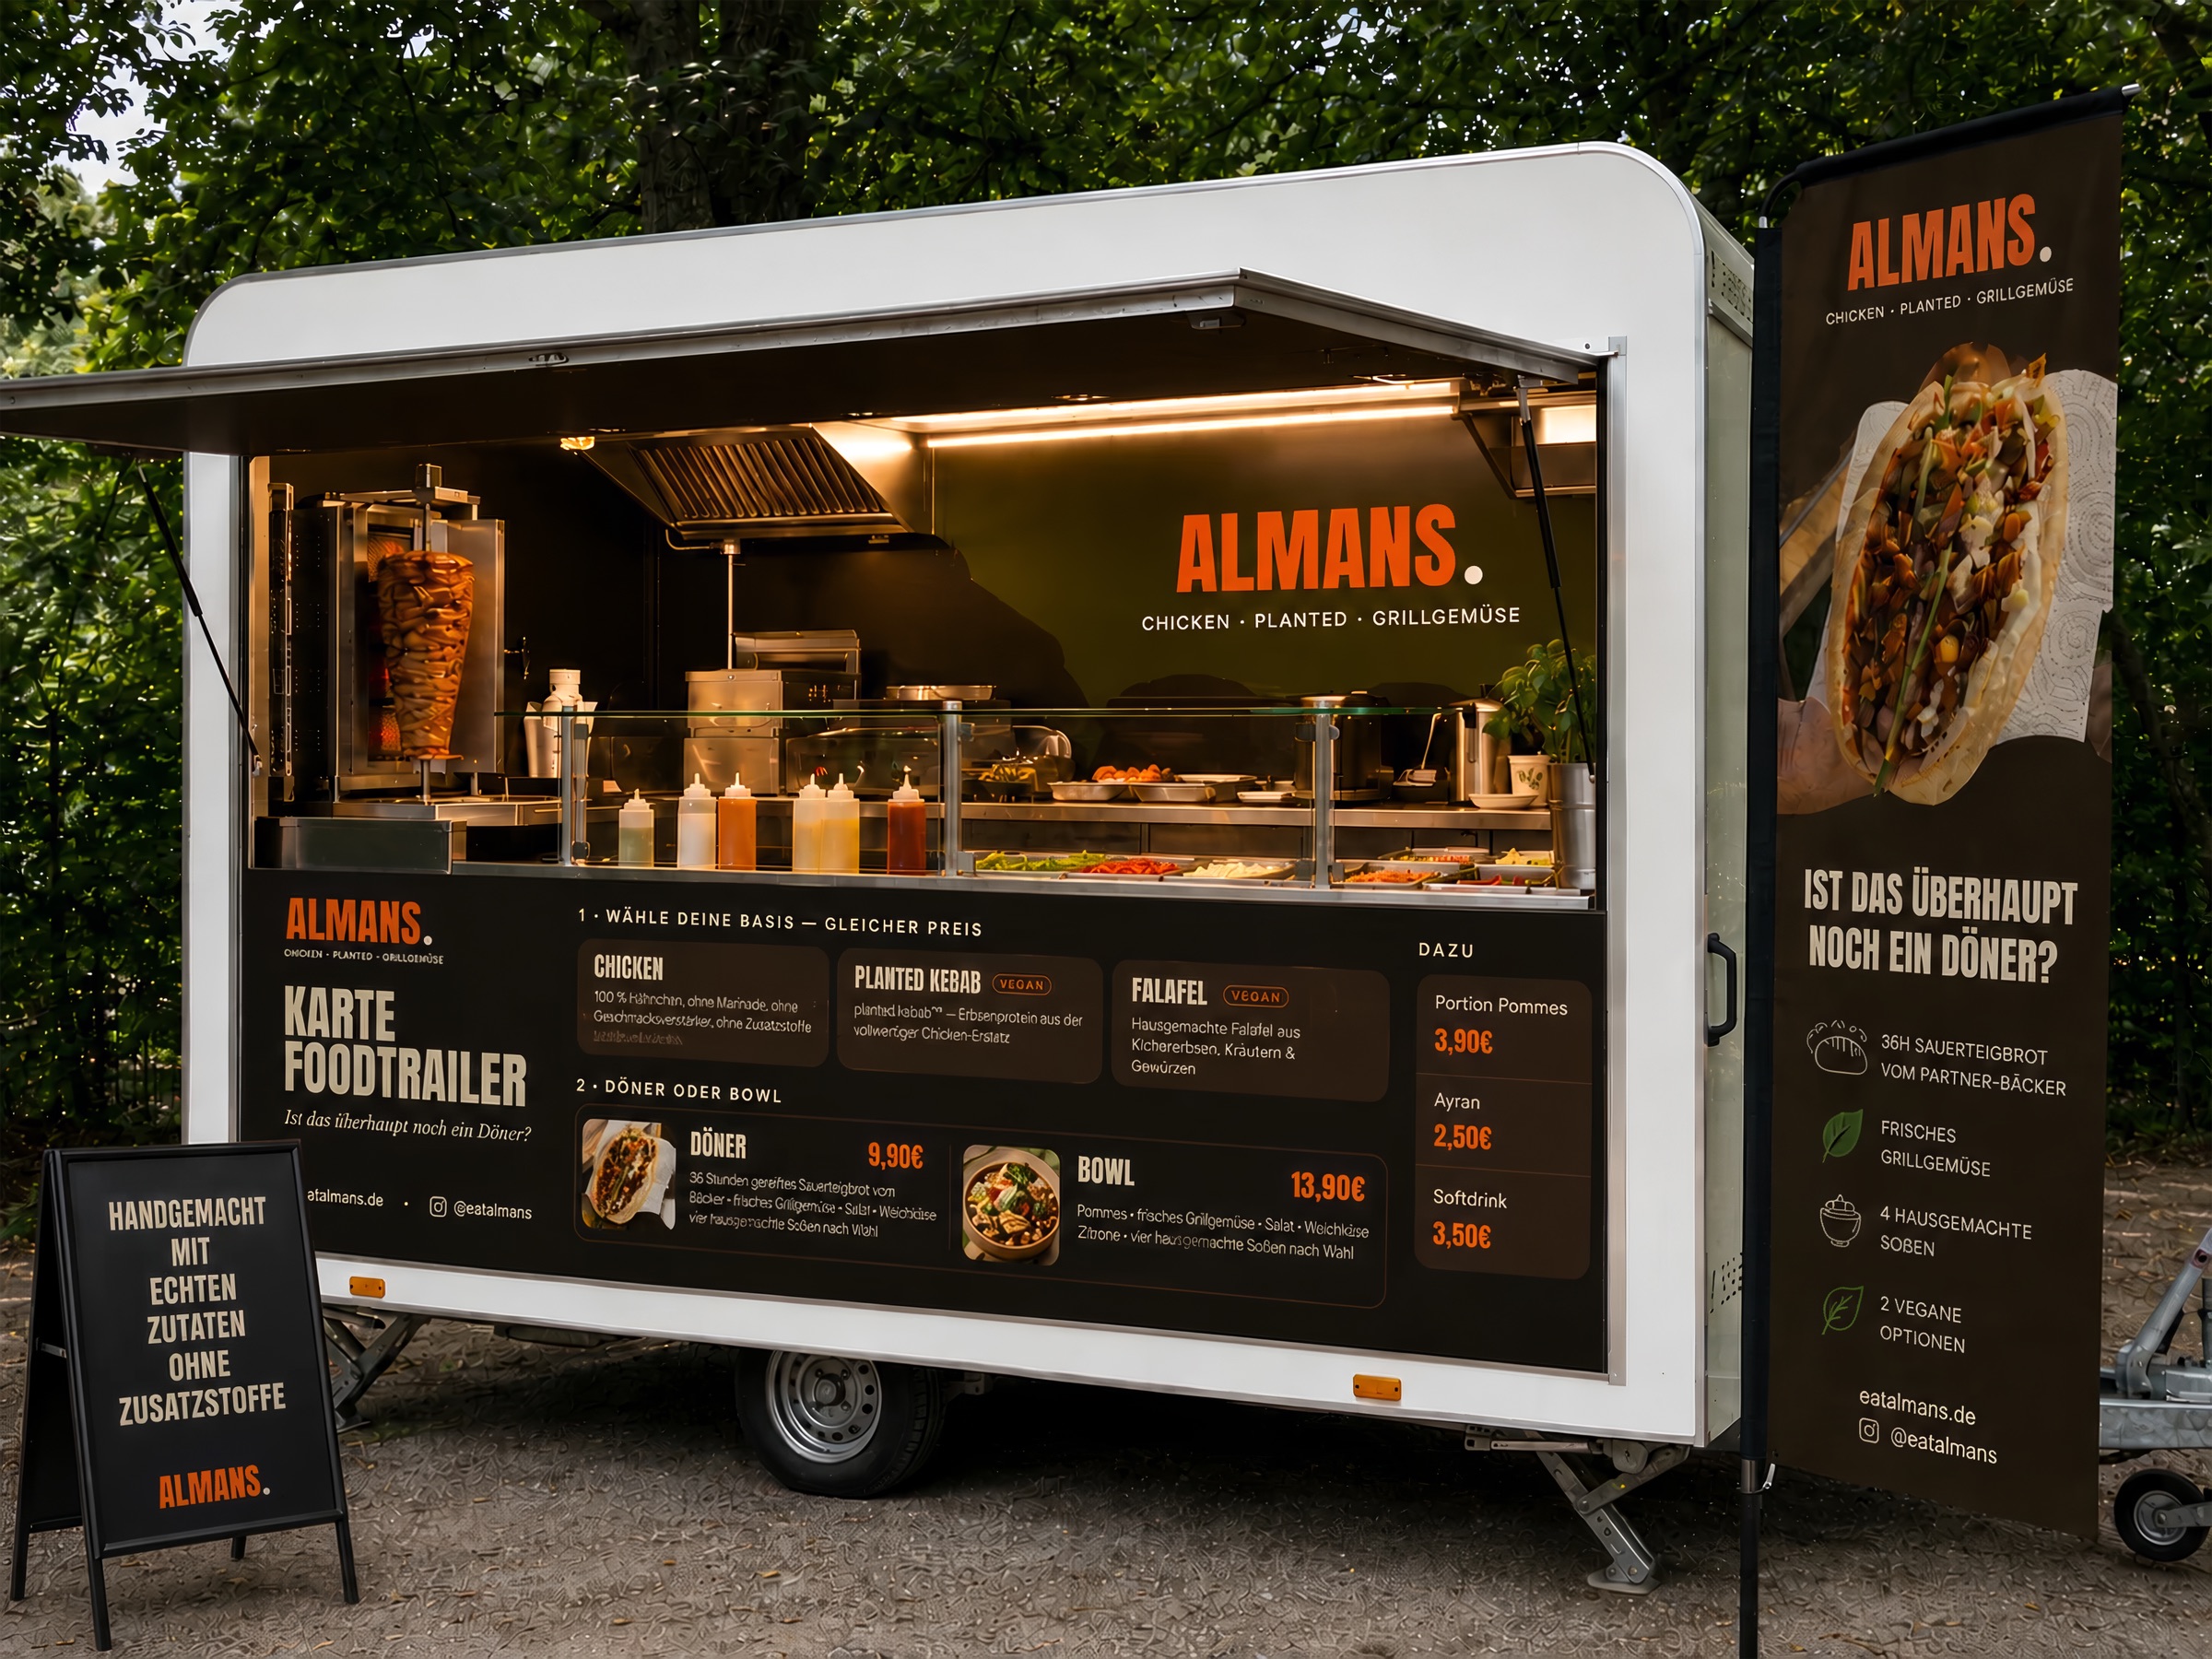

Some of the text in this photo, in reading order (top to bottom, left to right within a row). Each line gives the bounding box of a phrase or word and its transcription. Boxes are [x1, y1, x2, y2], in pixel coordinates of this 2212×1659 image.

[1847, 194, 2053, 291] ALMANS.
[1827, 277, 2073, 324] CHICKEN PLANTED GRILLGEMÜSE
[1177, 504, 1483, 593] ALMANS.
[1142, 604, 1519, 630] CHICKEN PLANTED GRILLGEMÜSE
[1805, 866, 2077, 924] IST DAS ÜBERHAUPT
[287, 898, 432, 945] ALMANS.
[579, 909, 583, 921] 1
[606, 907, 668, 924] WÄHLE
[678, 912, 730, 926] DEINE
[741, 914, 793, 929] BASIS
[826, 917, 917, 934] GLEICHER
[928, 922, 981, 936] PREIS
[1419, 943, 1472, 958] DAZU
[1810, 925, 2057, 983] NOCH EIN DÖNER?
[594, 954, 663, 980] CHICKEN
[855, 966, 1042, 994] PLANTED KEBAB VEGAN
[595, 991, 614, 1003] 100
[688, 995, 714, 1007] ohne
[771, 1000, 797, 1013] ohne
[1133, 978, 1279, 1005] FALAFEL VEGAN
[1436, 995, 1568, 1015] Portion Pommes
[285, 985, 394, 1041] KARTE
[716, 1016, 742, 1029] ohne
[1041, 1015, 1060, 1025] aus
[1064, 1014, 1082, 1026] der
[1133, 1018, 1228, 1034] Hausgemachte
[1277, 1028, 1300, 1038] aus
[1435, 1029, 1492, 1055] 3,90€
[1286, 1047, 1295, 1059] &
[1882, 1034, 2048, 1065] 36H SAUERTEIGBROT
[286, 1041, 526, 1107] FOODTRAILER
[1881, 1063, 2065, 1096] VOM PARTNER-BÄCKER
[577, 1077, 781, 1102] 2 DÖNER ODER BOWL
[1434, 1093, 1479, 1112] Ayran
[307, 1111, 331, 1126] das
[413, 1120, 446, 1135] noch
[452, 1123, 473, 1137] ein
[477, 1124, 531, 1141] Döner?
[1434, 1124, 1491, 1150] 2,50€
[1882, 1121, 1956, 1143] FRISCHES
[691, 1127, 923, 1170] DÖNER 9,90€
[1881, 1149, 1990, 1177] GRILLGEMÜSE
[1078, 1156, 1365, 1202] BOWL 13,90€
[308, 1189, 383, 1206] atalmans.de
[1077, 1205, 1127, 1219] Pommes
[1434, 1189, 1507, 1208] Softdrink
[109, 1196, 265, 1230] HANDGEMACHT
[1880, 1206, 2032, 1241] 4 HAUSGEMACHTE
[1131, 1230, 1152, 1242] vier
[1247, 1239, 1286, 1253] Soßen
[1289, 1244, 1319, 1256] nach
[1324, 1244, 1353, 1259] Wahl
[1433, 1221, 1490, 1249] 3,50€
[171, 1237, 209, 1266] MIT
[150, 1274, 236, 1305] ECHTEN
[1881, 1296, 1961, 1323] 2 VEGANE
[147, 1310, 245, 1344] ZUTATEN
[1880, 1325, 1964, 1353] OPTIONEN
[170, 1350, 230, 1381] OHNE
[119, 1382, 286, 1426] ZUSATZSTOFFE
[1859, 1390, 1976, 1425] eatalmans.de
[1891, 1428, 1996, 1464] @eatalmans
[159, 1465, 270, 1509] ALMANS.
